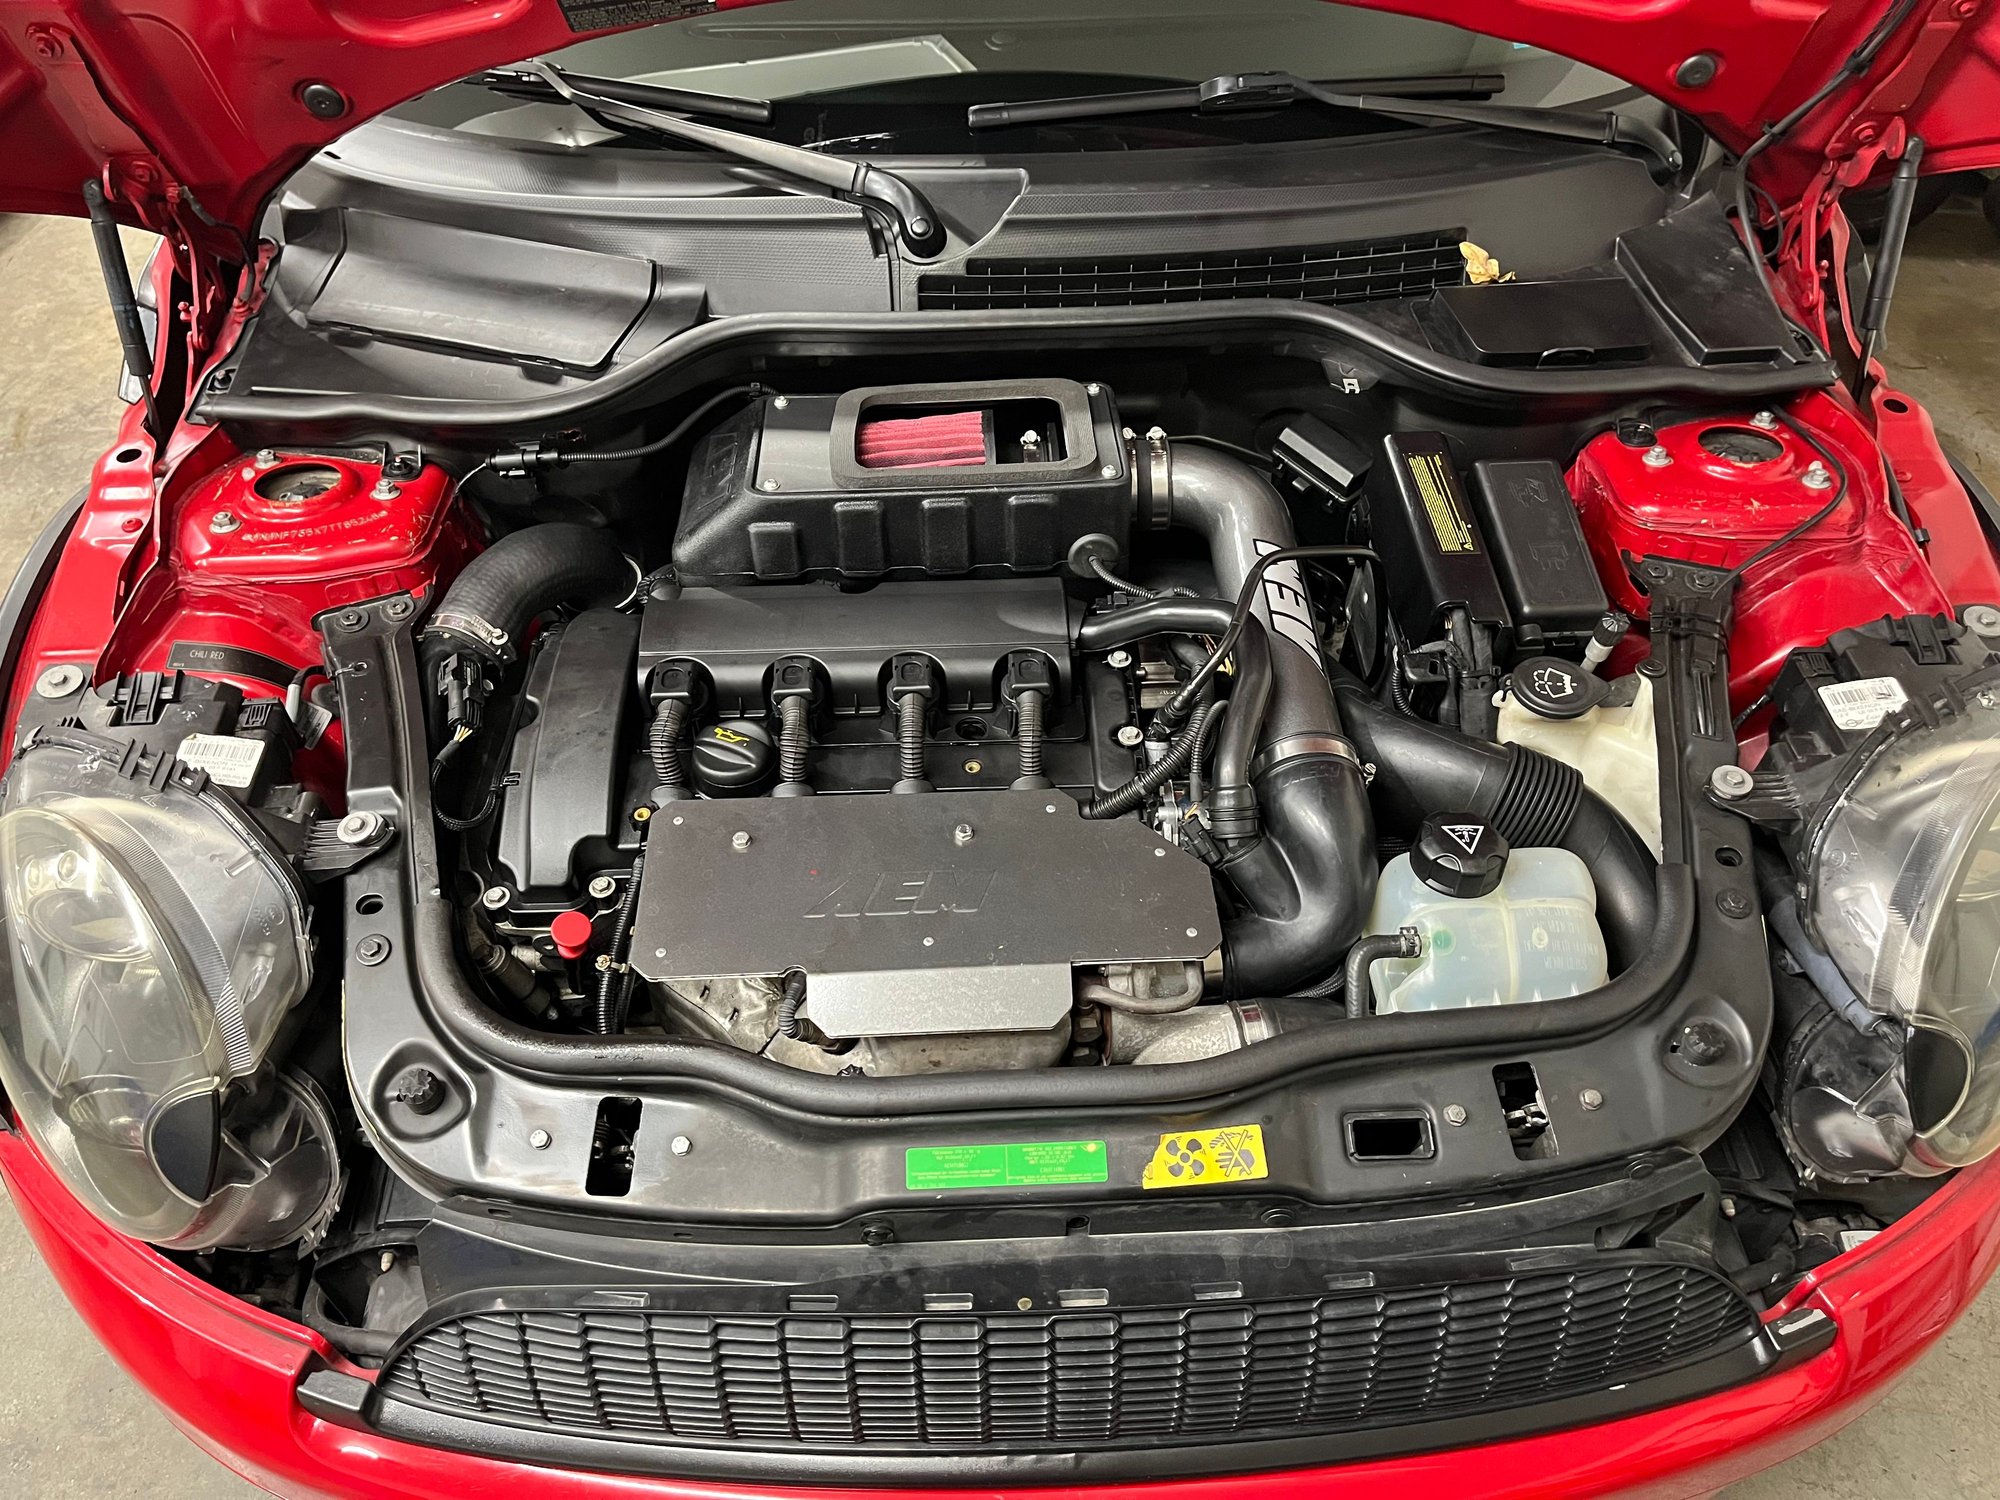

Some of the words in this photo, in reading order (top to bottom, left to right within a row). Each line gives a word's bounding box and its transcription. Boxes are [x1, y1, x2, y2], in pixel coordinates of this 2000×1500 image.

[189, 649, 208, 659] CHILI
[209, 650, 225, 660] RED
[803, 869, 998, 918] AEM
